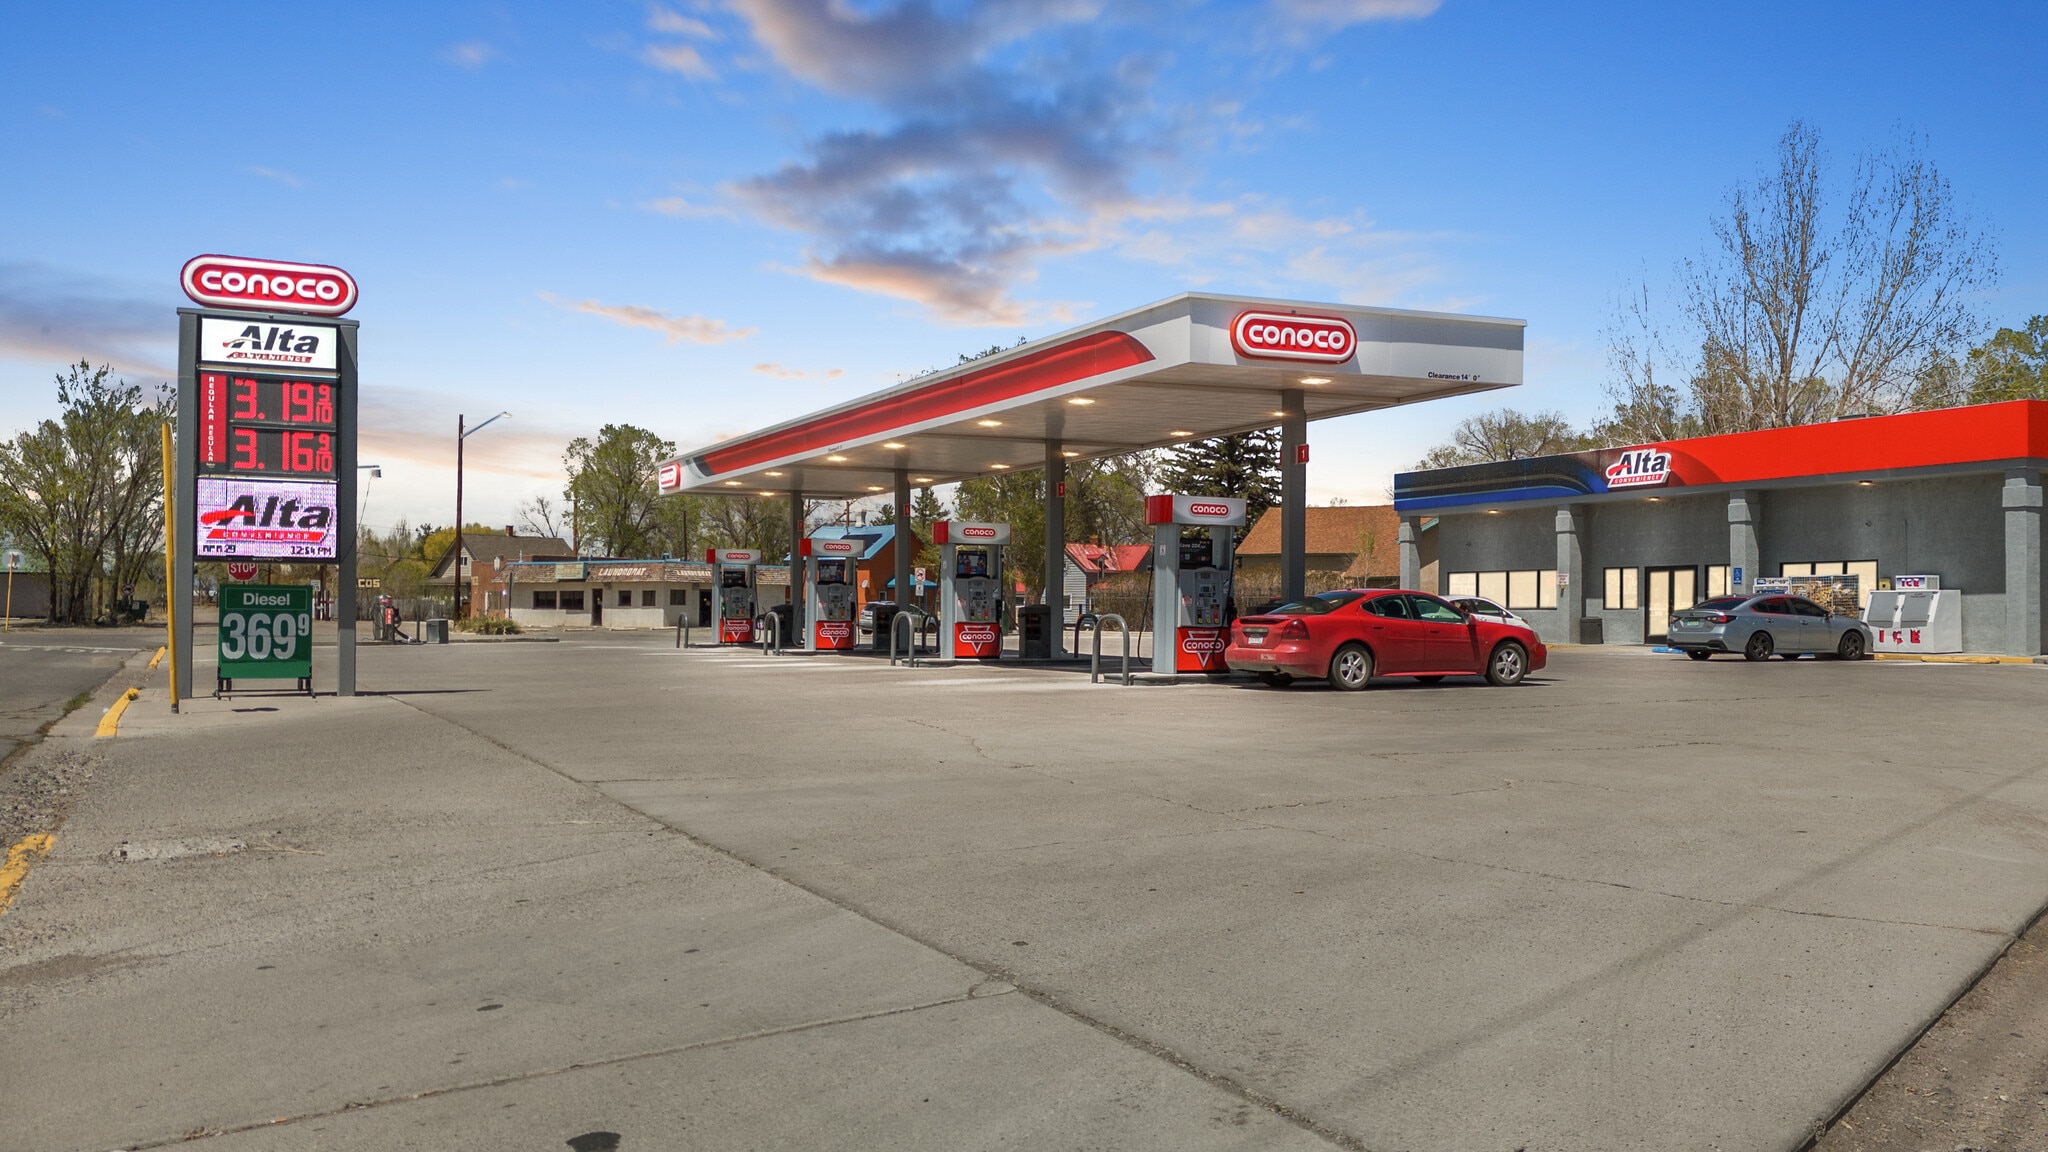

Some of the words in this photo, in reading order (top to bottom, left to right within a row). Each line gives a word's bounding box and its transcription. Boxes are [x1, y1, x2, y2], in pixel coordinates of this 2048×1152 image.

[230, 325, 320, 354] Alta
[231, 351, 309, 363] CONVENIENCE
[1427, 371, 1461, 380] Clearance
[1615, 452, 1667, 476] Alta
[1614, 474, 1660, 484] CONVENIENCE
[216, 495, 331, 528] Alta
[230, 563, 256, 574] STOP
[1901, 578, 1920, 587] ICE
[243, 593, 290, 606] Diesel
[1879, 629, 1921, 645] ICE
